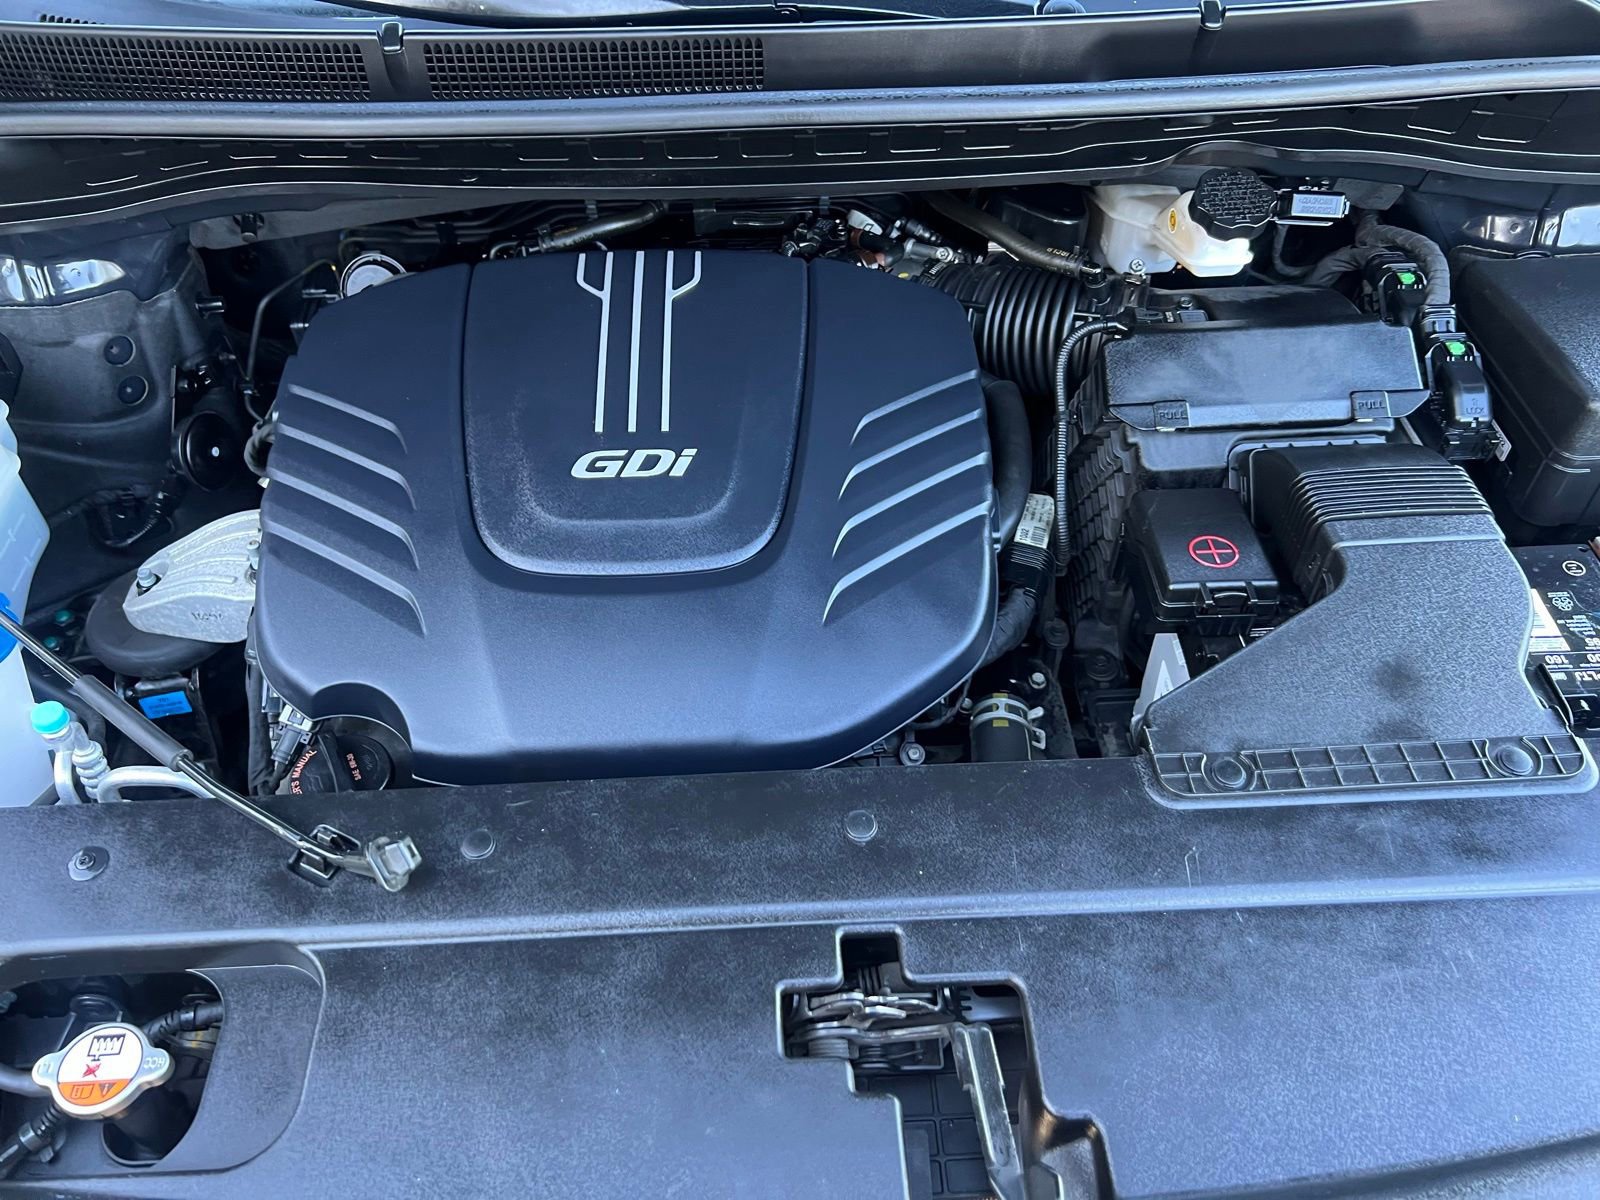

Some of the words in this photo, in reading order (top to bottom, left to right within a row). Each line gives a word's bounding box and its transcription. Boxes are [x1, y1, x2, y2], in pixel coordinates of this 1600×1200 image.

[1358, 400, 1386, 410] PULL
[1158, 409, 1188, 420] PULL
[570, 448, 698, 479] GDi
[1544, 654, 1569, 665] 160
[291, 749, 318, 778] MANUAL
